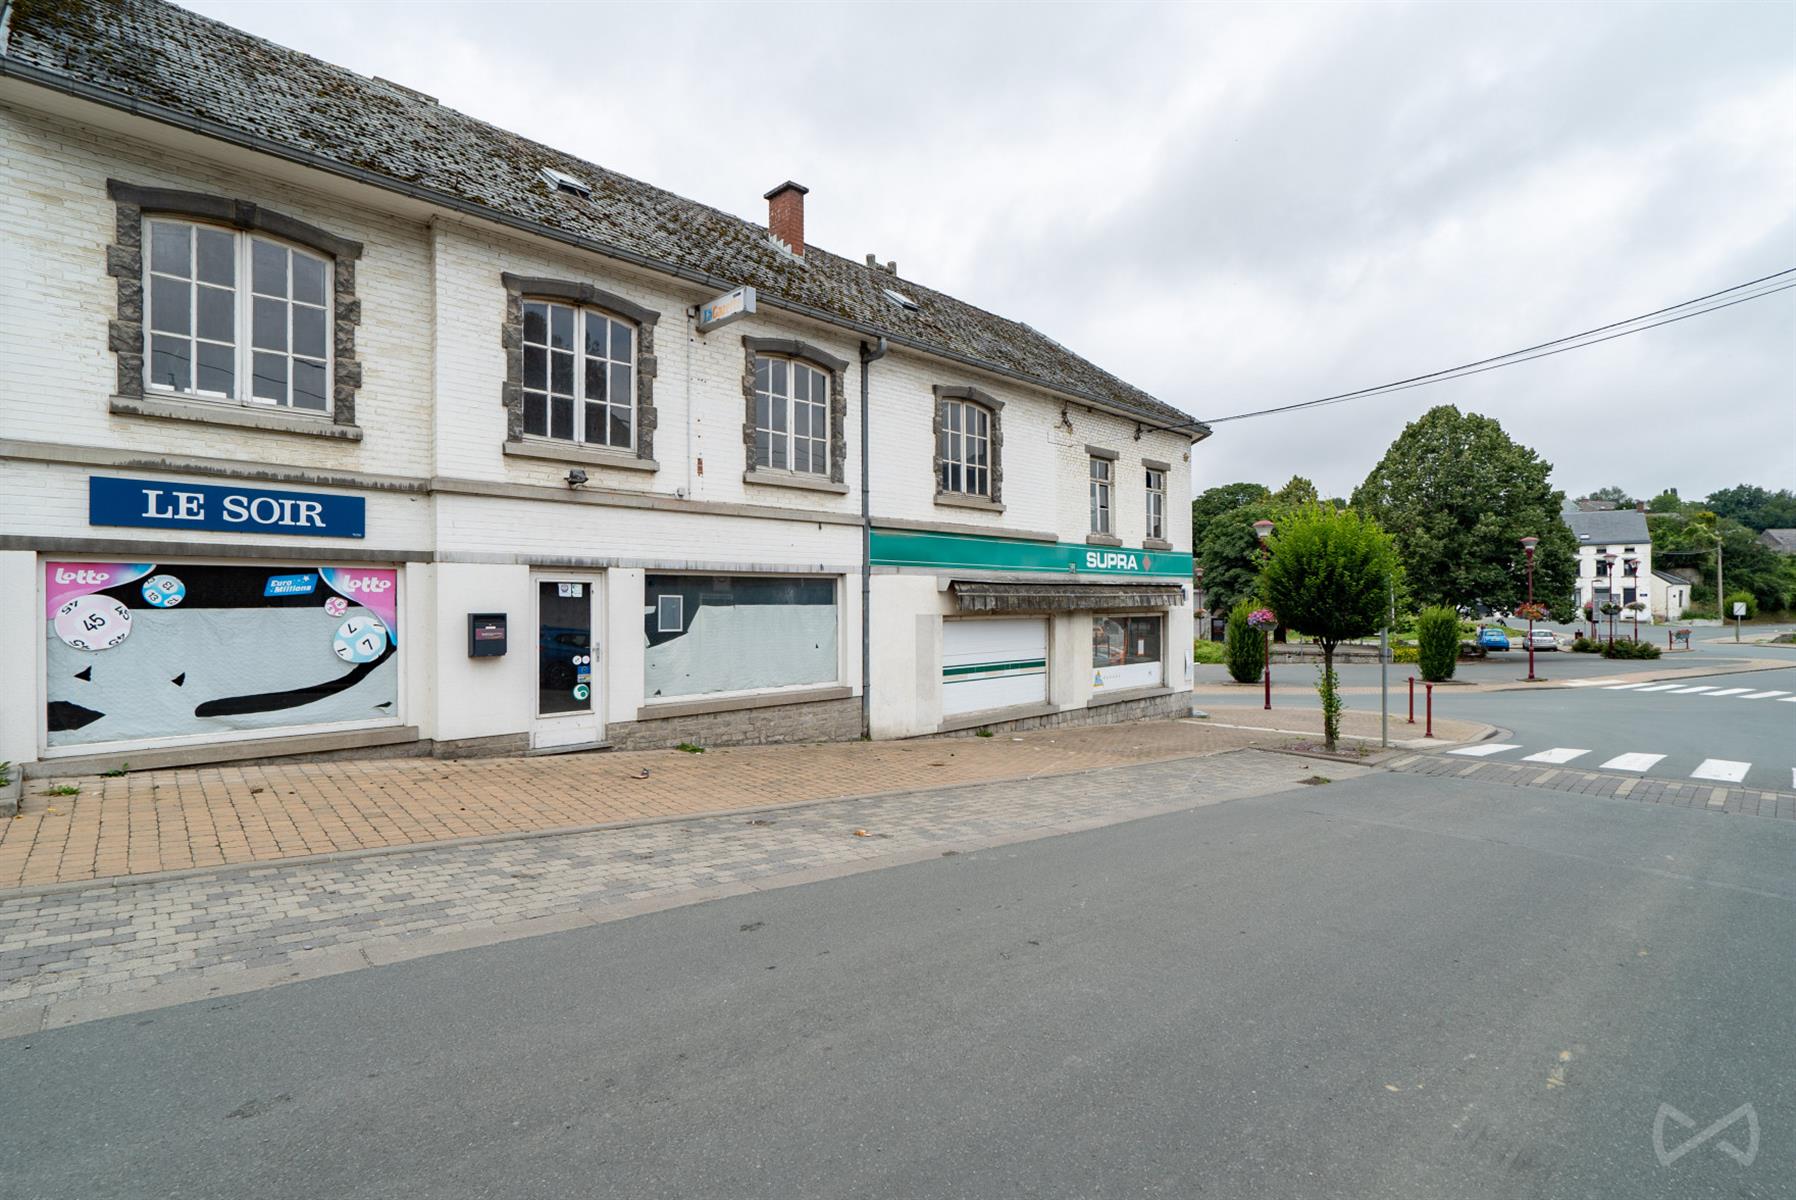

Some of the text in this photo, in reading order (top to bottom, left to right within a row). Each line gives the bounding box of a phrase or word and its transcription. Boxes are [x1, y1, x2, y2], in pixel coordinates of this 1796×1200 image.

[142, 489, 326, 527] LE SOIR
[1086, 551, 1138, 570] SUPRA
[55, 567, 110, 585] Lotto
[343, 575, 391, 592] Lotto
[274, 585, 312, 593] Millions
[114, 605, 130, 621] 45
[83, 613, 106, 631] 45
[362, 638, 374, 651] 7
